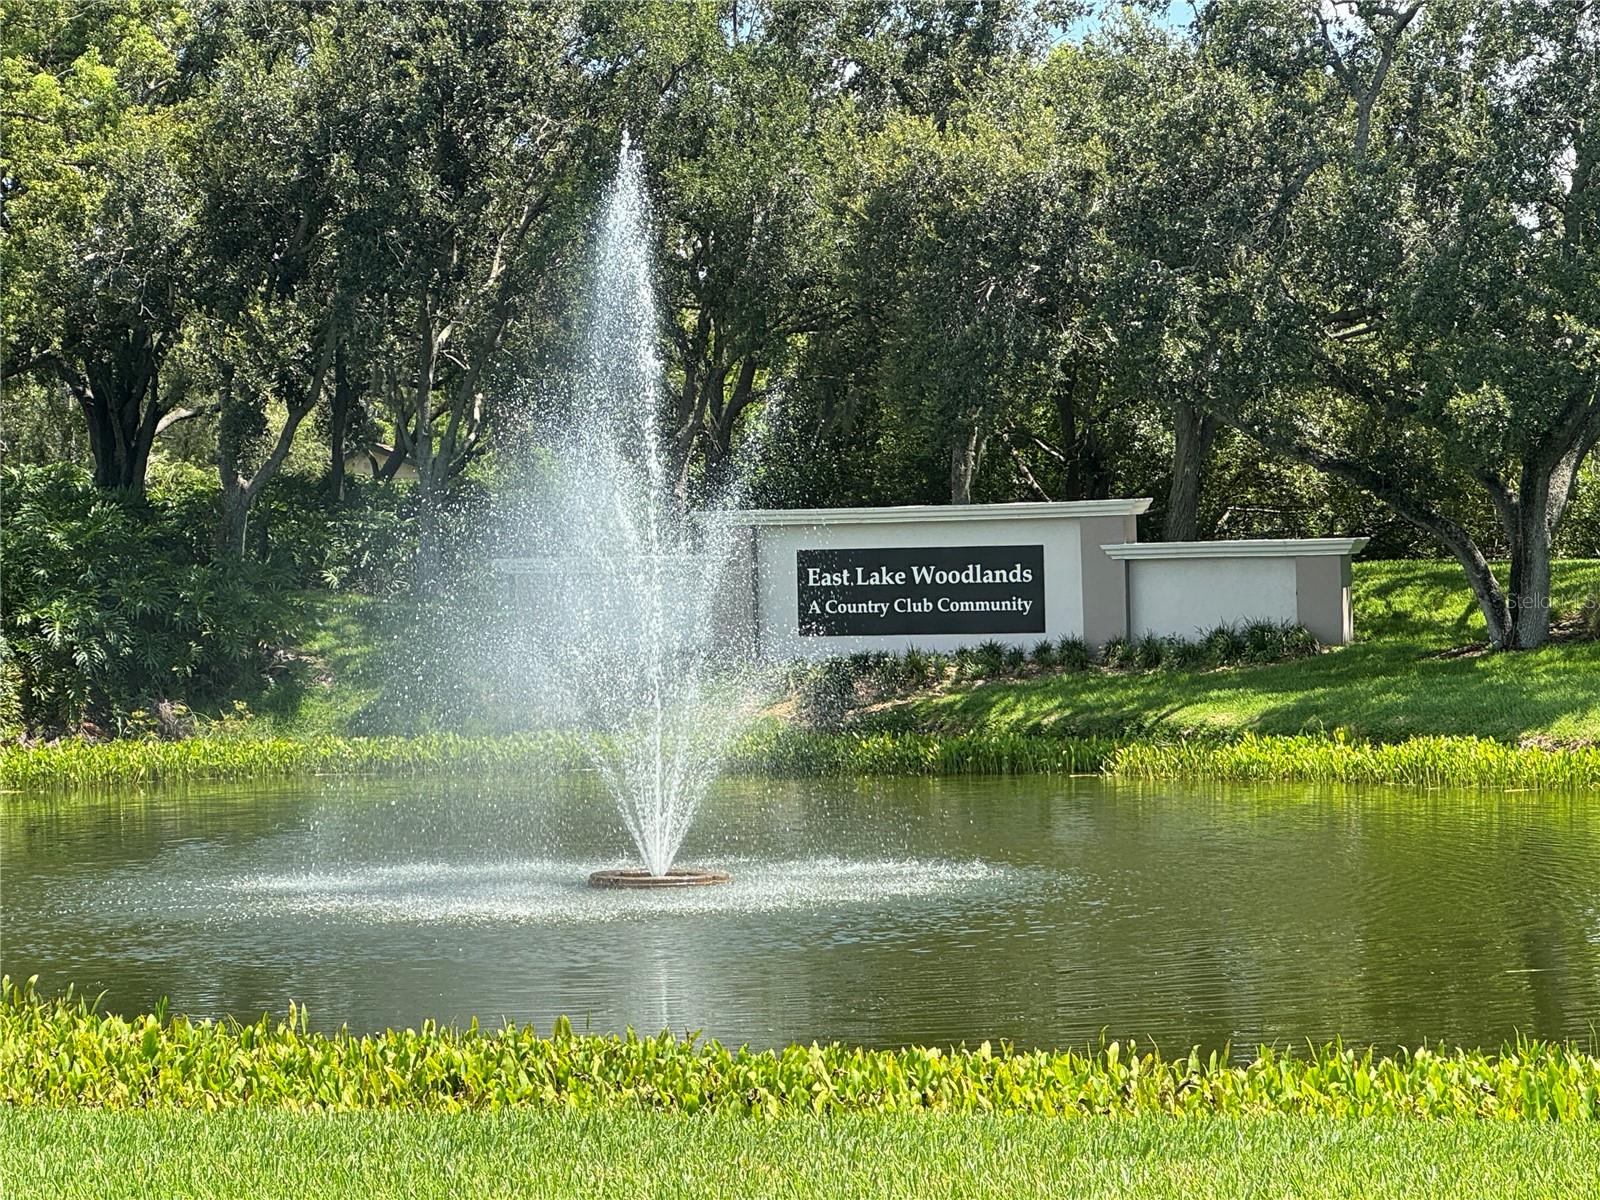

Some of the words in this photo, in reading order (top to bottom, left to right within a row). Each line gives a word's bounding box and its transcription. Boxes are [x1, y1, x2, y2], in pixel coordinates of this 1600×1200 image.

[807, 567, 850, 586] East
[856, 564, 906, 585] Lake
[911, 564, 1033, 585] Woodlands
[808, 601, 821, 614] A
[825, 599, 889, 617] Country
[894, 598, 933, 612] Club
[937, 597, 1033, 615] Community
